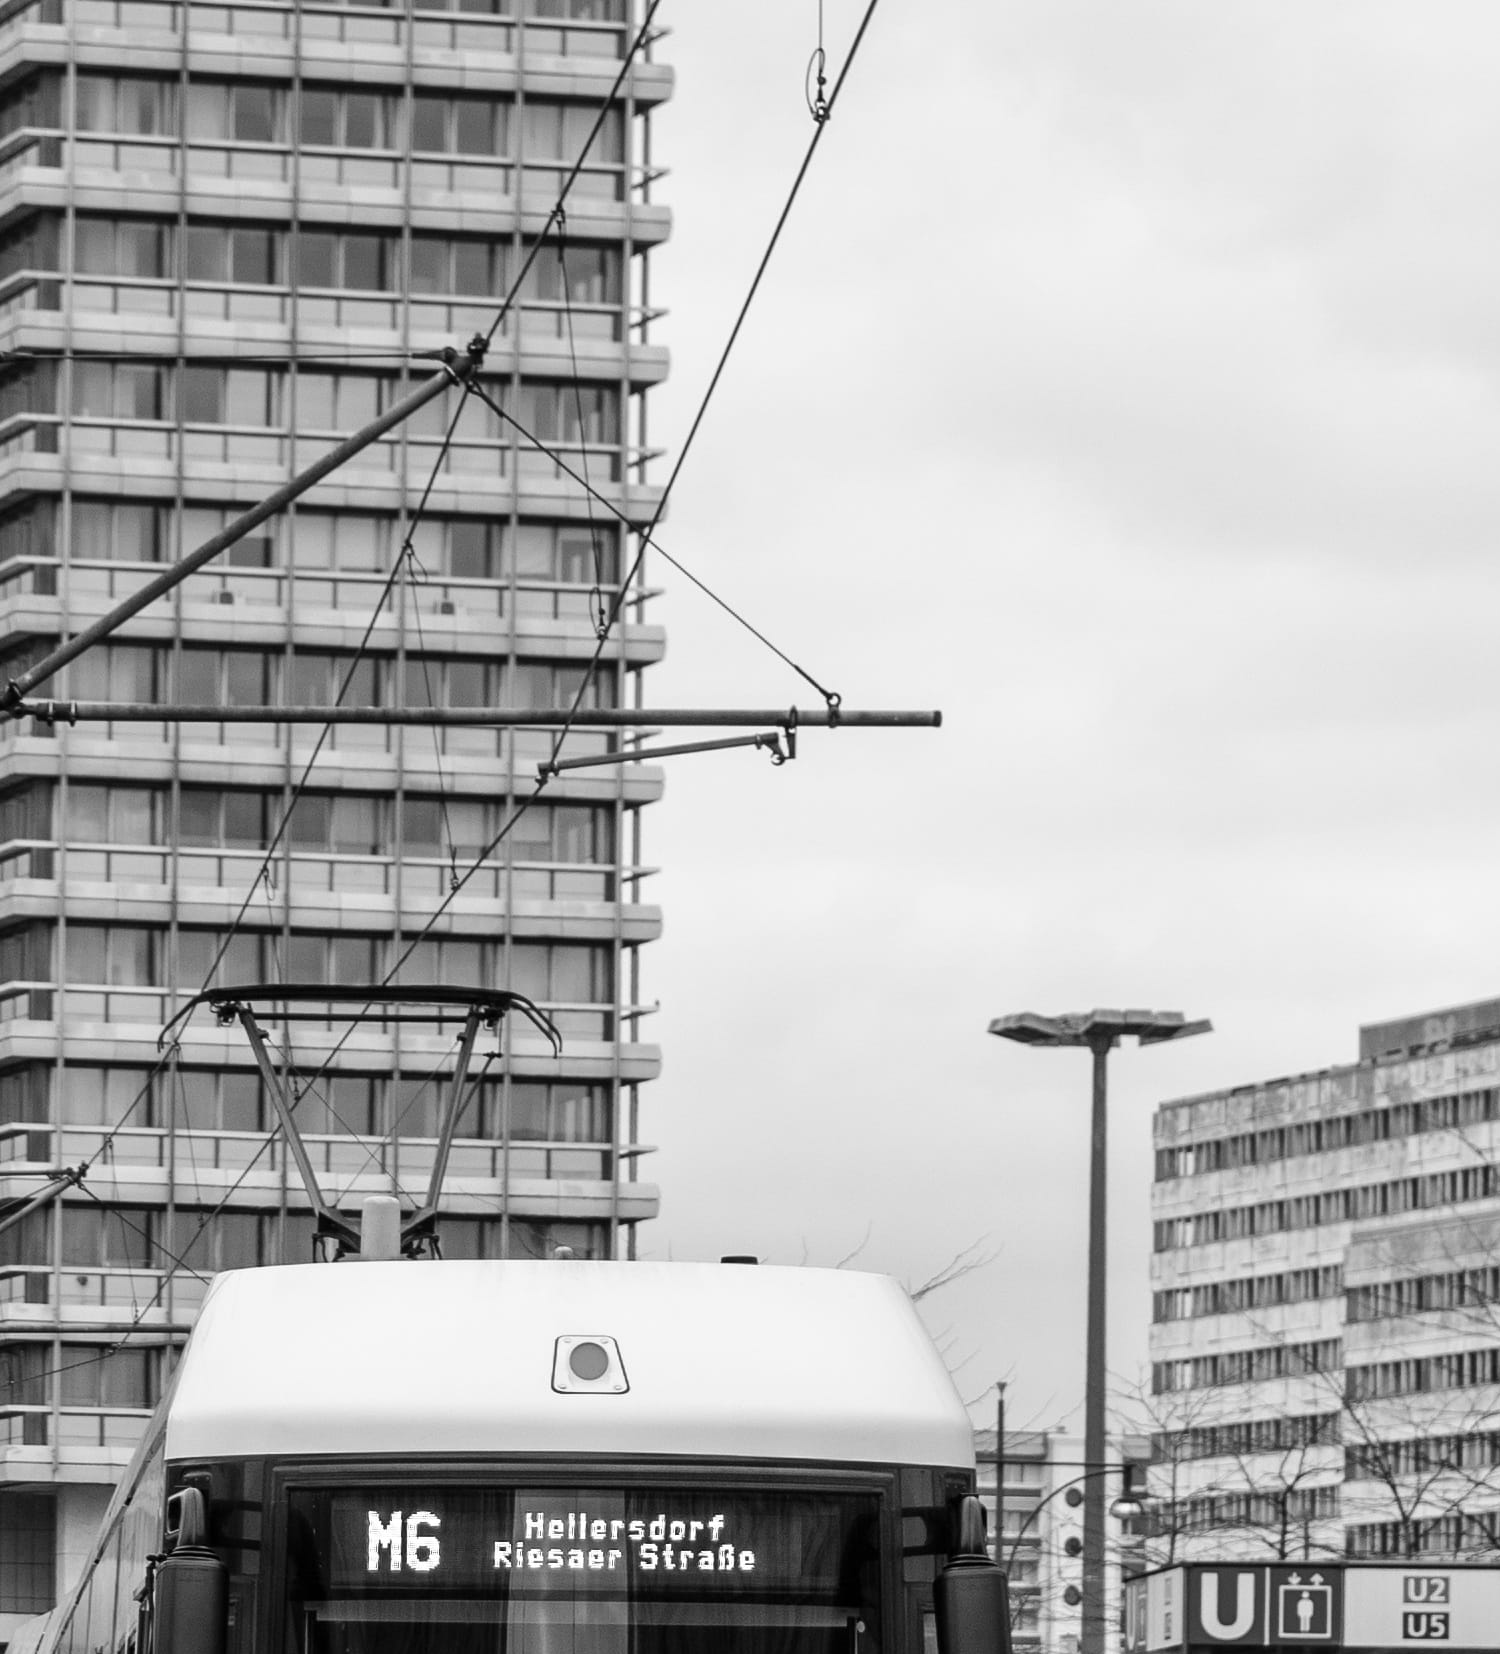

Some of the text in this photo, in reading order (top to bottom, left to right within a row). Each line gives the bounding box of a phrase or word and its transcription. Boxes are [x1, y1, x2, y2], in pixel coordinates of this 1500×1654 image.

[367, 1510, 441, 1571] M6
[525, 1512, 725, 1541] Hellersdorf
[494, 1541, 756, 1571] Riesaer Straße
[1407, 1578, 1446, 1601] U2
[1200, 1572, 1255, 1640] U
[1407, 1614, 1446, 1637] U5
